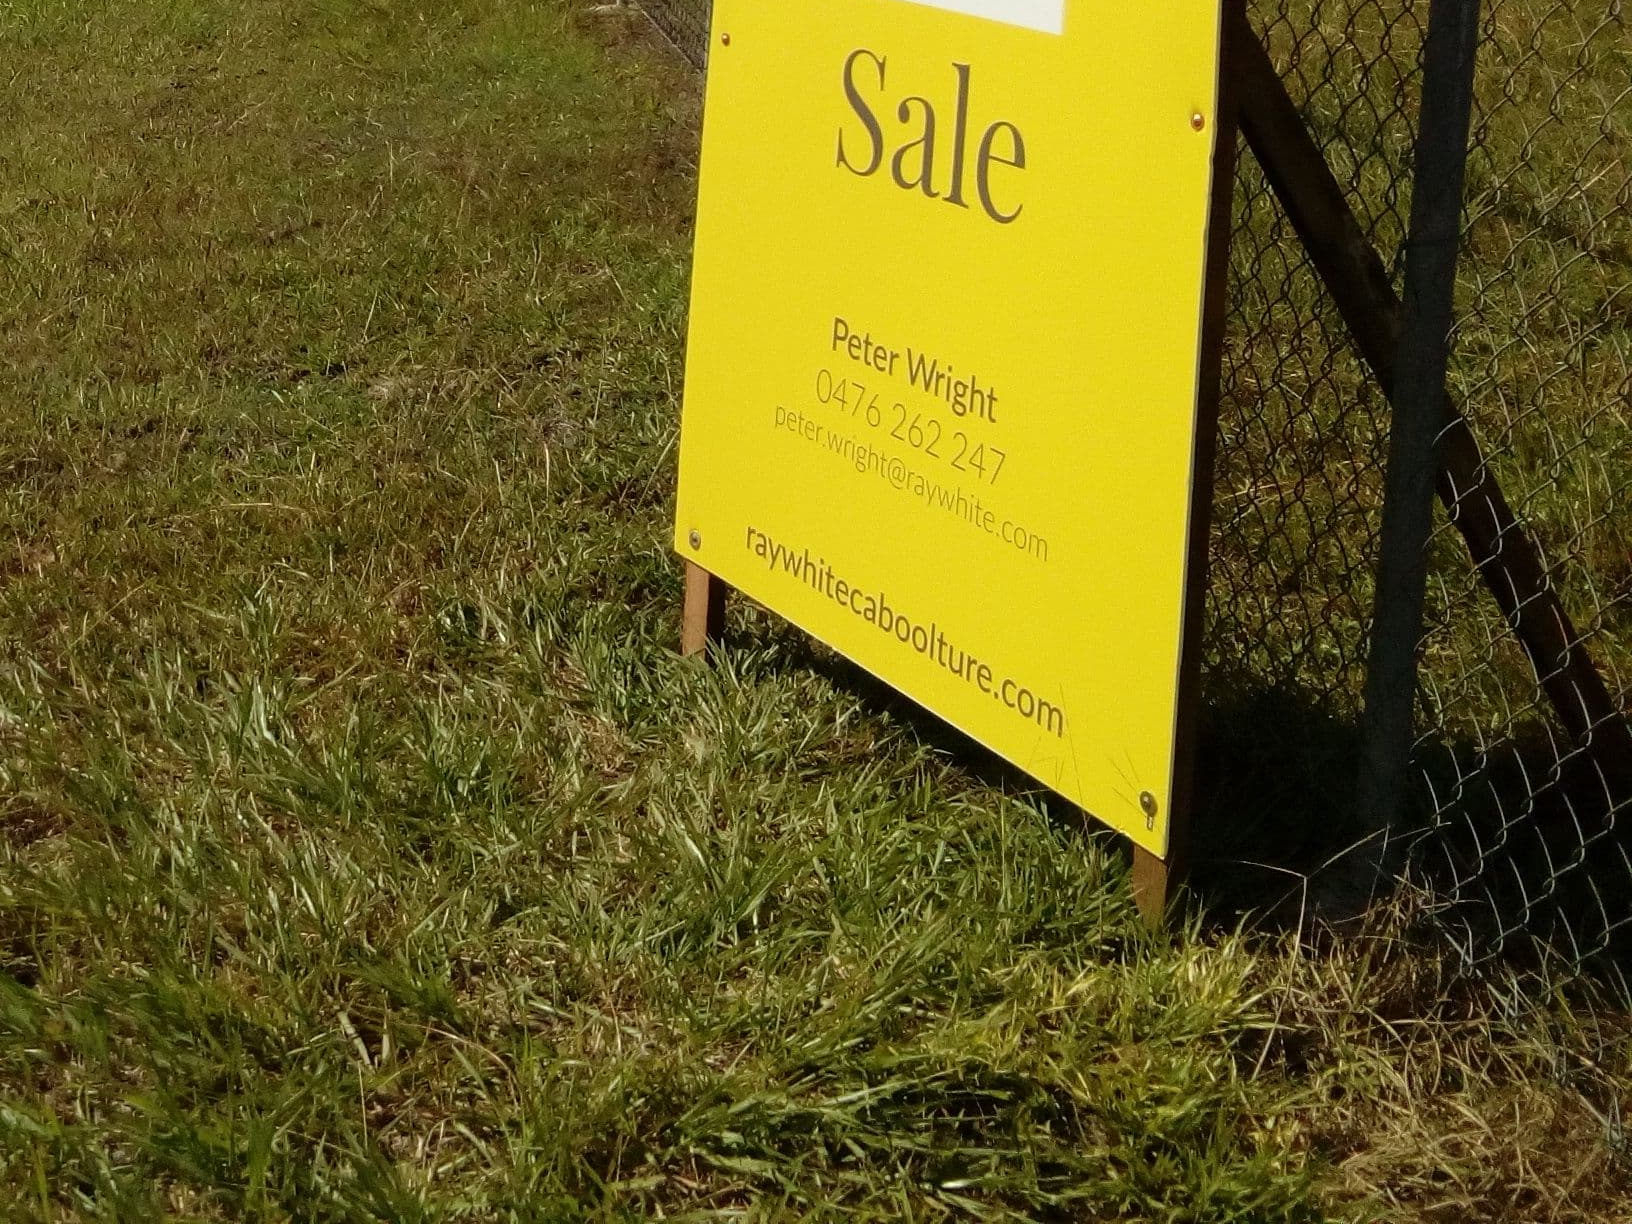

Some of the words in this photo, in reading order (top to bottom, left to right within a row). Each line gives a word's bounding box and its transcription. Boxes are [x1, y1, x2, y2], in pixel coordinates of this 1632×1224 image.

[835, 48, 1026, 225] Sale
[815, 368, 882, 428] 0476
[890, 402, 942, 459] 262
[950, 431, 1007, 486] 247
[831, 316, 900, 377] Peter
[906, 347, 999, 424] Wright
[774, 404, 1050, 563] peter.wright@raywhite.com
[745, 524, 1065, 739] raywhitecaboolture.com
